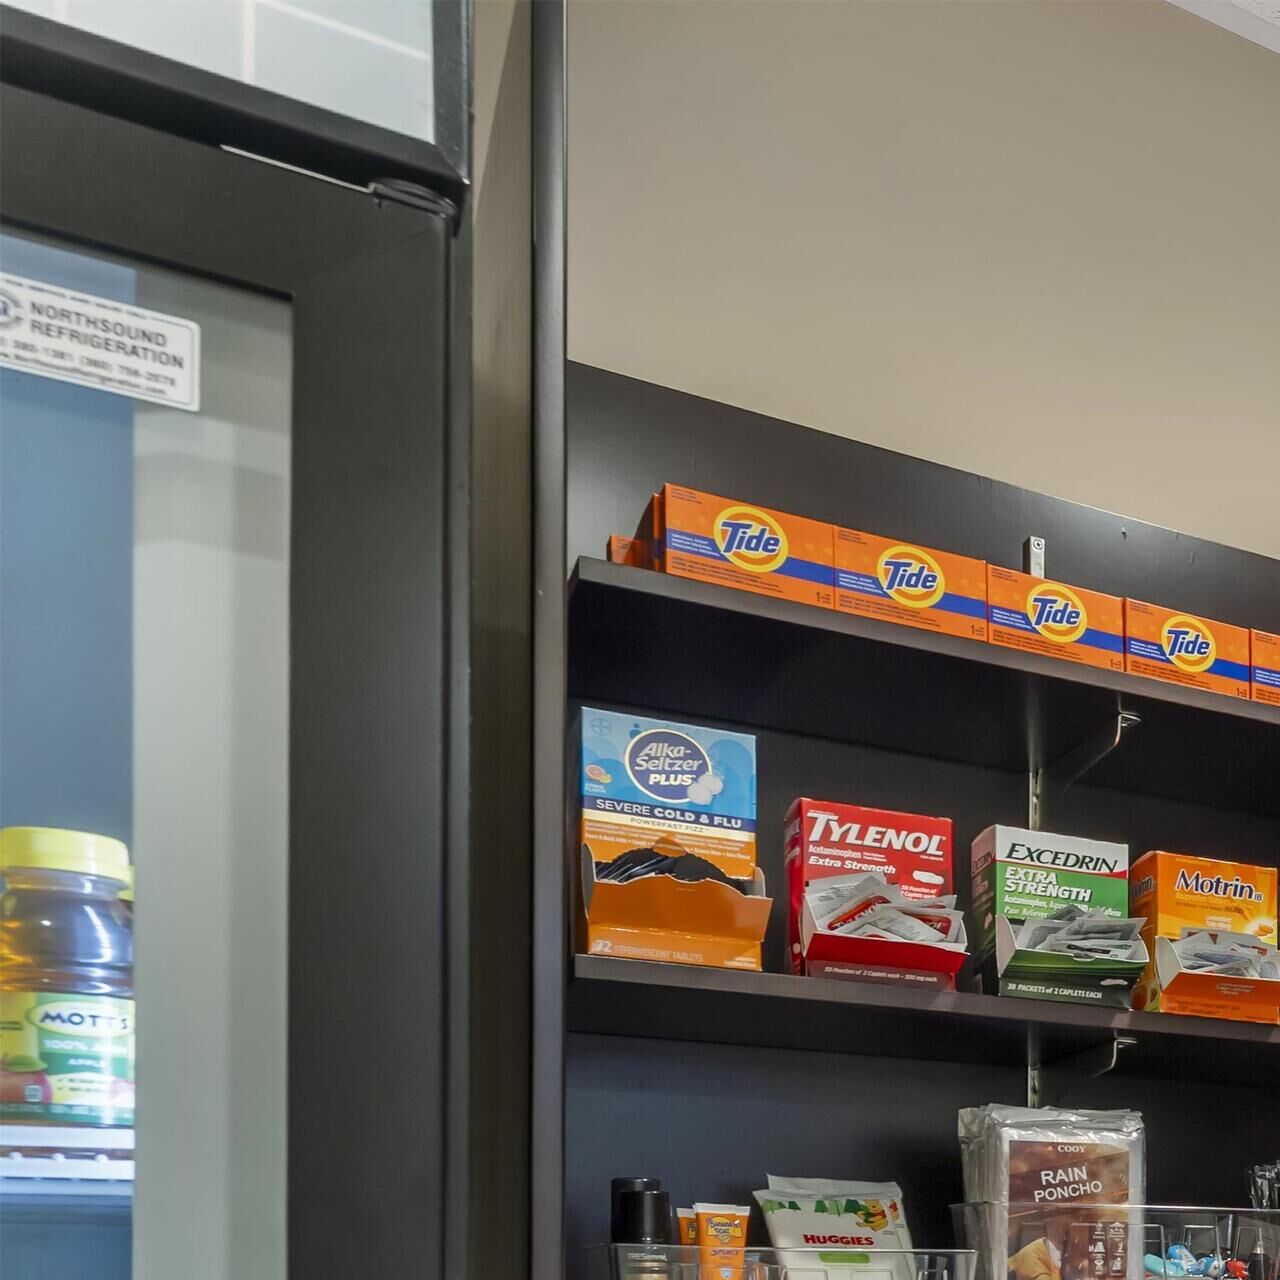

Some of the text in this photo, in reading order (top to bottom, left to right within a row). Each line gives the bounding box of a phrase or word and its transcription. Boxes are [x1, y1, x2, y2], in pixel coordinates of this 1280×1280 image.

[30, 302, 167, 347] NORTHSOUND
[30, 319, 184, 369] REFRIGERATION
[721, 521, 781, 555] Tide
[883, 560, 938, 591] Tide
[1033, 597, 1081, 627] Tide
[1167, 629, 1211, 657] Tide
[638, 742, 692, 758] Alka-
[634, 756, 703, 772] Seltzer
[648, 773, 693, 786] PLUS
[596, 800, 742, 828] SEVERE COLD & FLU
[630, 817, 683, 831] POWERFAST
[807, 812, 947, 856] TYLENOL
[809, 856, 896, 874] Extra Strength
[1005, 843, 1118, 873] EXCEDRIN
[1004, 867, 1057, 885] EXTRA
[1175, 869, 1255, 900] Motrin
[1004, 880, 1093, 902] STRENGTH
[1041, 1166, 1088, 1186] RAIN
[1034, 1180, 1102, 1202] PONCHO
[803, 1234, 874, 1246] HUGGIES
